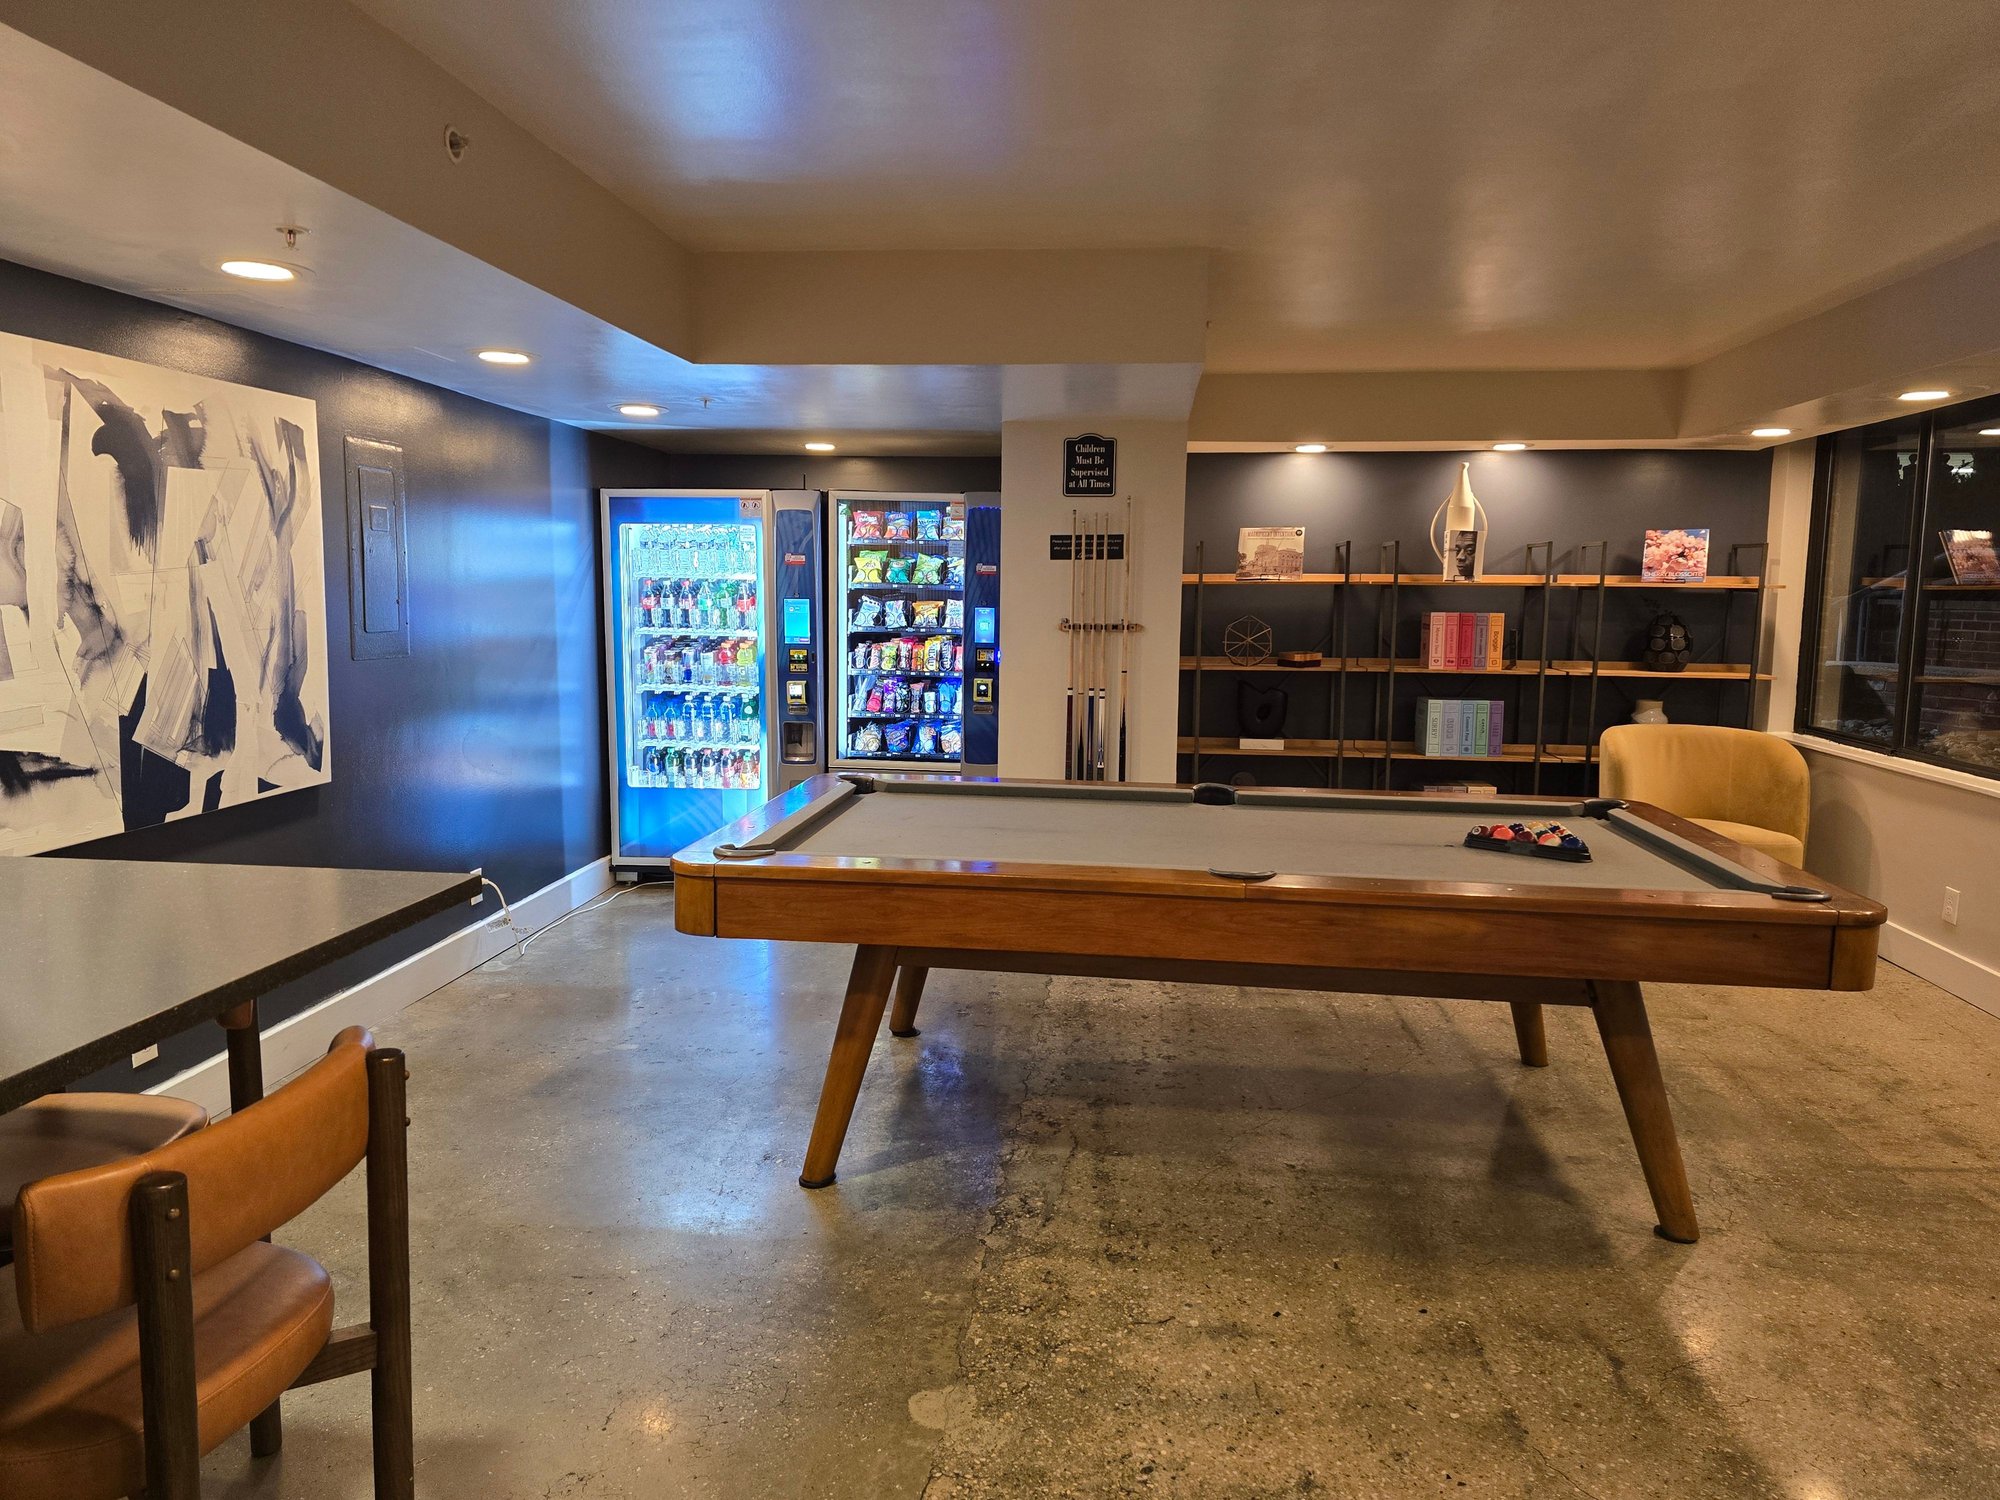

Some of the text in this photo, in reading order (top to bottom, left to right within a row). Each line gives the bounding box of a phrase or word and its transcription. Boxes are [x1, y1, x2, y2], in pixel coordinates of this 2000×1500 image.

[1075, 444, 1105, 453] Children
[1076, 456, 1105, 464] Must Be
[1070, 467, 1109, 478] Supervised
[1068, 479, 1111, 488] at All Times
